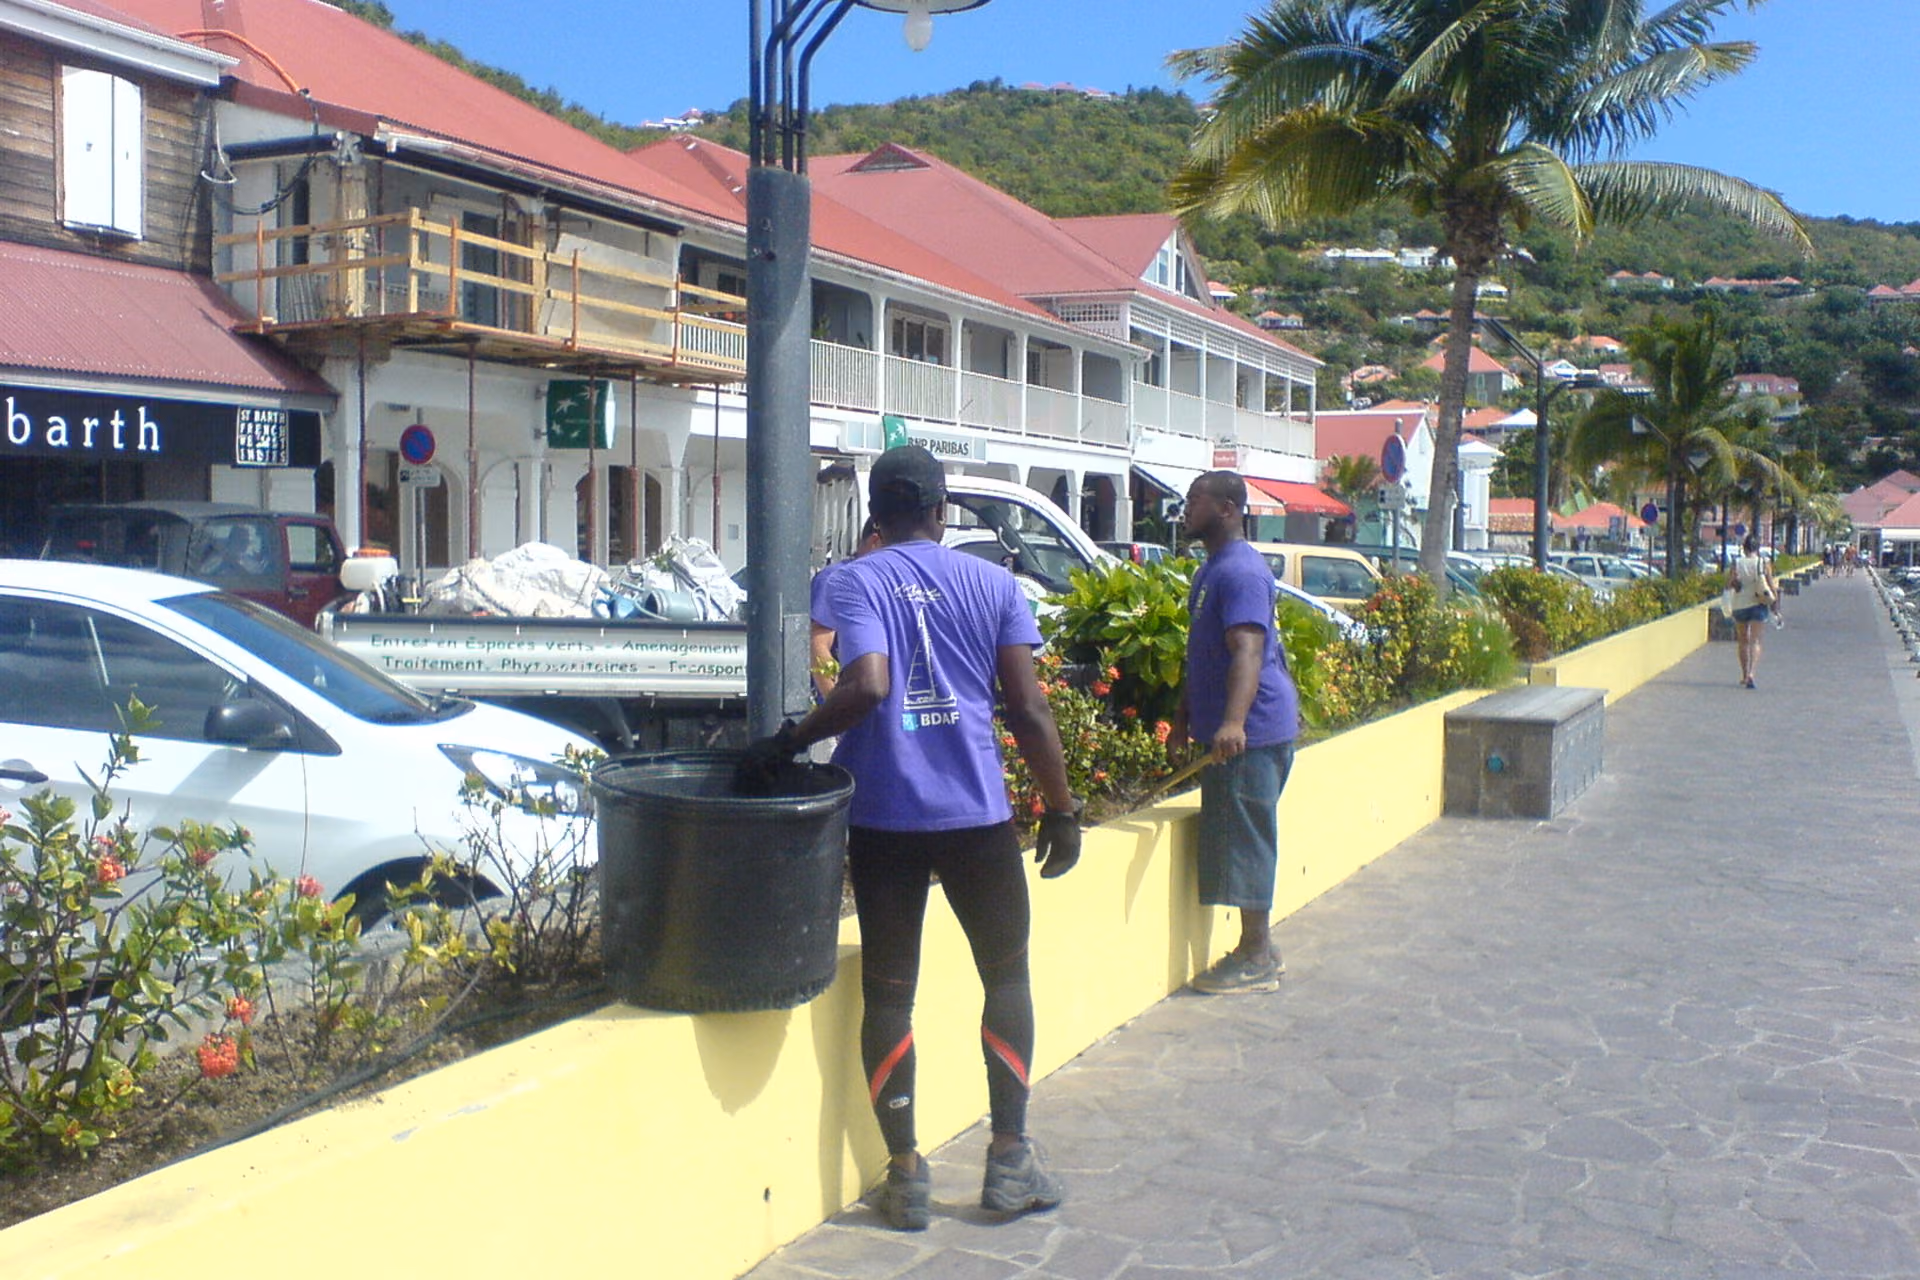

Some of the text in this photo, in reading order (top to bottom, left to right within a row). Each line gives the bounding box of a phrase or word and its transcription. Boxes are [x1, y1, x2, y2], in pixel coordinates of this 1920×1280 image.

[5, 396, 160, 451] barth
[254, 410, 286, 424] BARTH
[240, 422, 287, 437] FRENCH
[930, 439, 969, 456] PARIBAS
[371, 634, 457, 649] Entreten
[382, 656, 490, 672] Traitement
[669, 660, 747, 677] Transpor
[921, 711, 960, 727] BDAF
